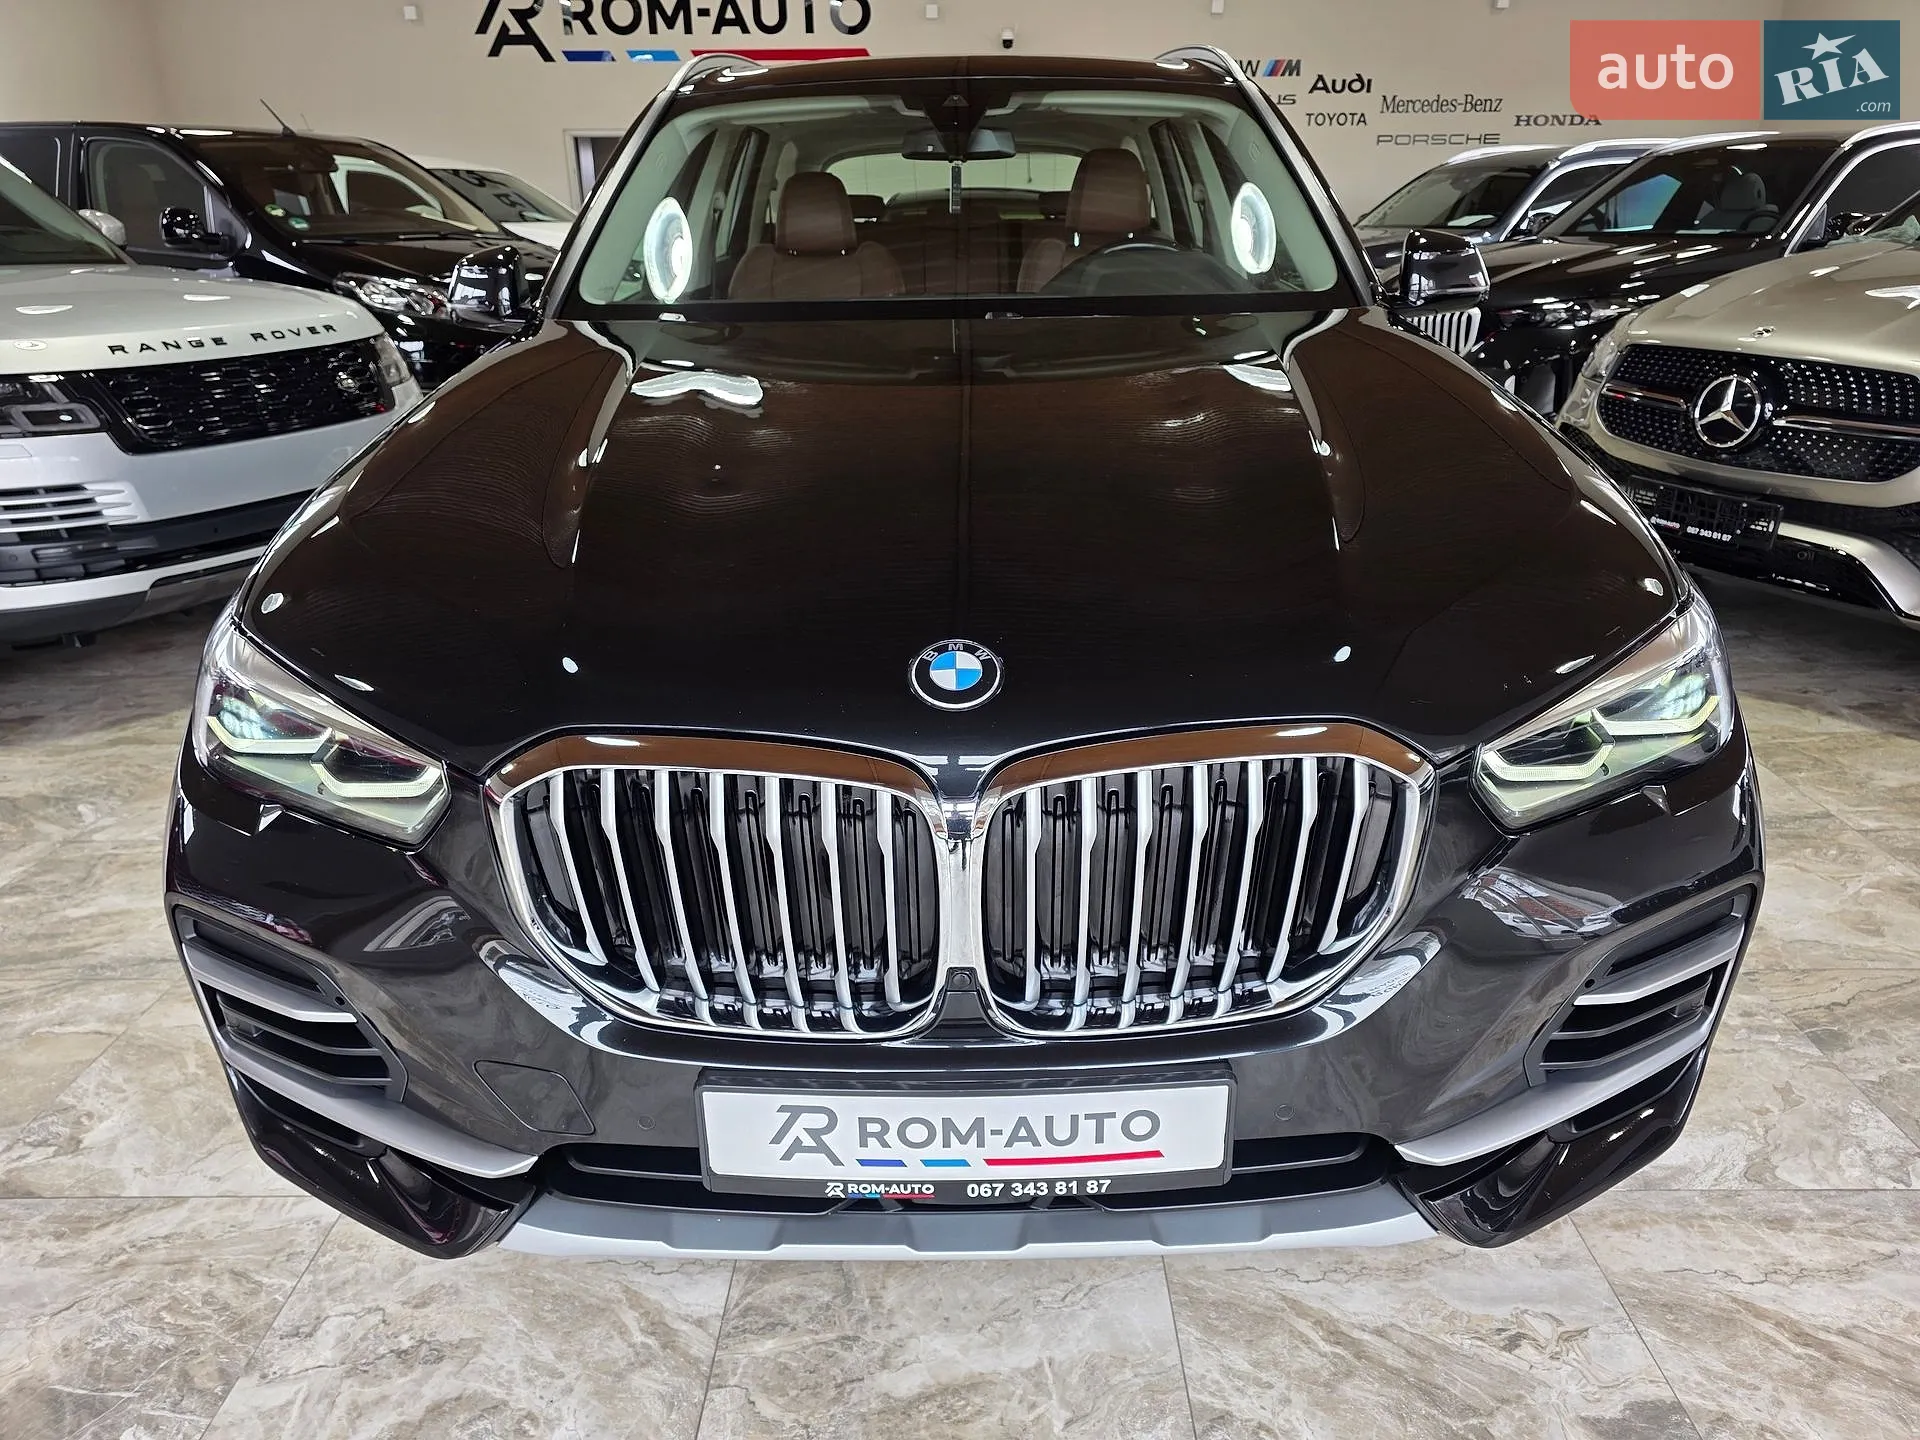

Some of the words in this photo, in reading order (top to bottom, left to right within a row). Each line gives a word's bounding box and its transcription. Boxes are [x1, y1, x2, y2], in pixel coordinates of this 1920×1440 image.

[1308, 73, 1373, 94] Audi
[1380, 94, 1503, 114] Mercedes-Benz
[1306, 112, 1368, 126] TOYOTA
[1514, 114, 1602, 127] HONDA
[1376, 133, 1501, 146] PORSCHE
[107, 337, 228, 355] RANGE
[250, 324, 337, 342] ROVER
[922, 643, 991, 662] BMW
[858, 1109, 1161, 1149] ROM-AUTO
[847, 1183, 935, 1194] ROM-AUTO
[966, 1183, 1005, 1198] 067
[1010, 1182, 1049, 1197] 343
[1054, 1180, 1079, 1195] 81
[1085, 1179, 1112, 1194] 87
